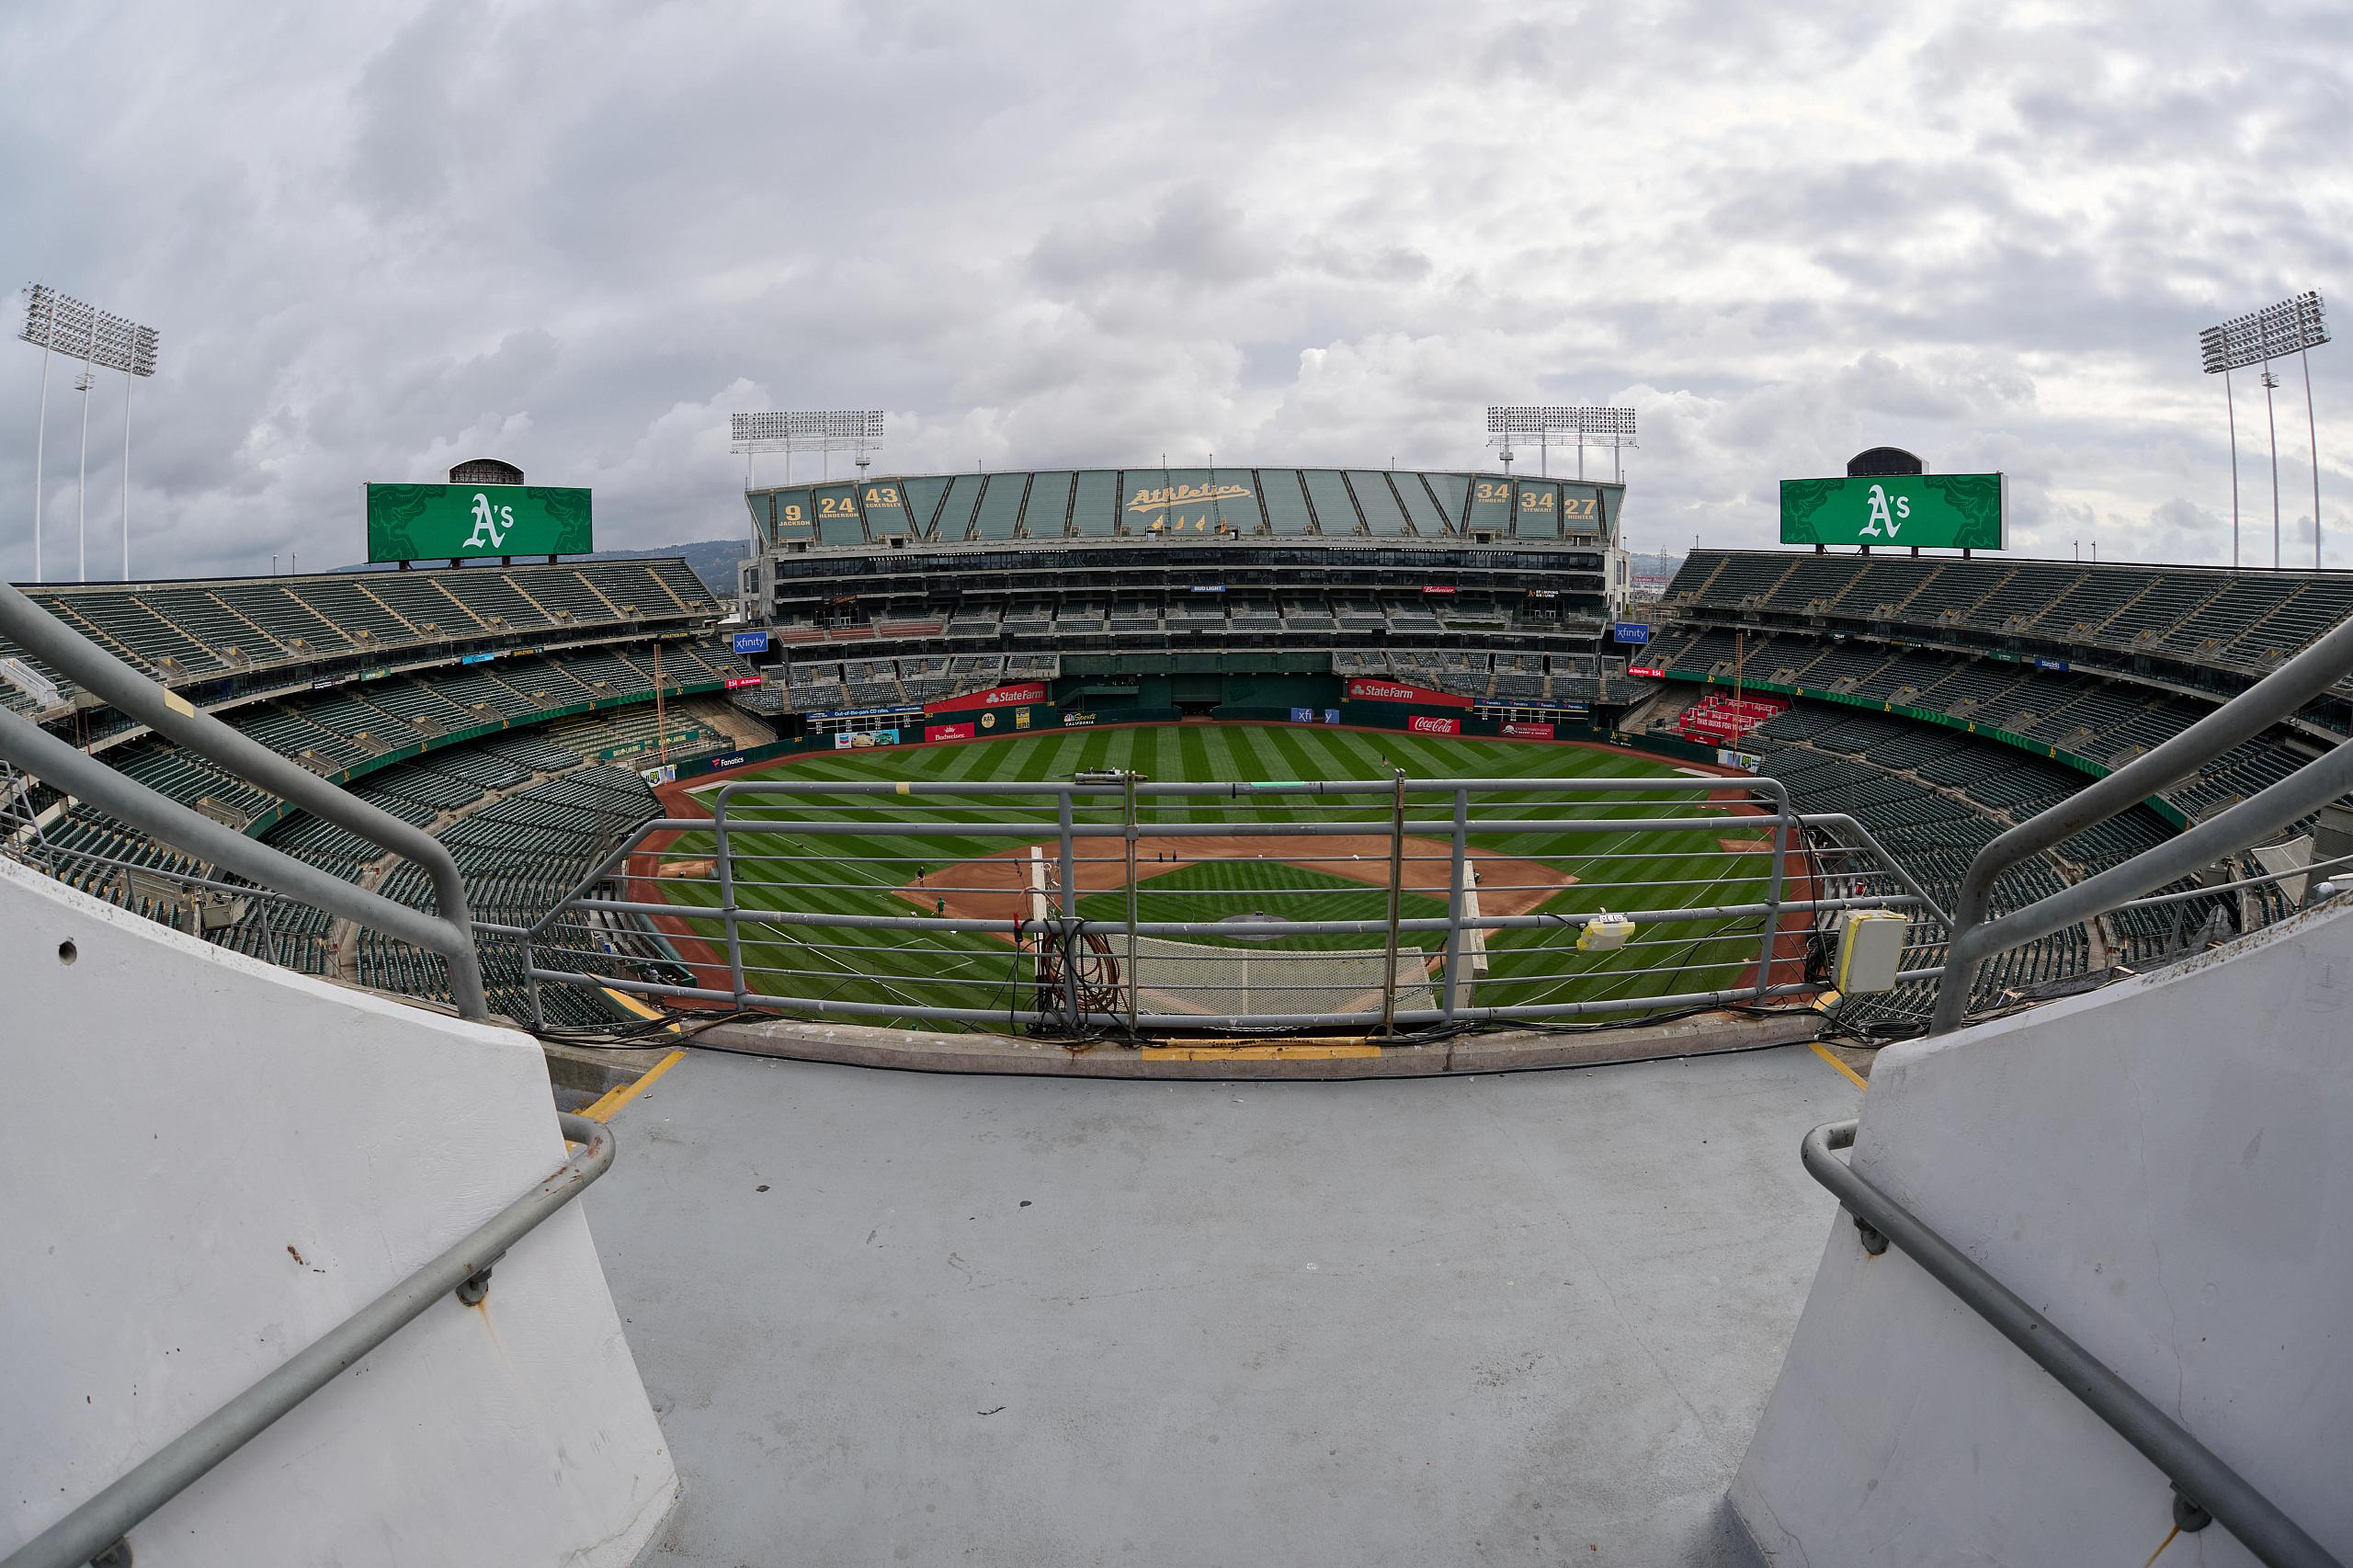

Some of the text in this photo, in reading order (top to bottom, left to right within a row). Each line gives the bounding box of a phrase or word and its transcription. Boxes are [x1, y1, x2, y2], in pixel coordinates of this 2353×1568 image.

[865, 488, 898, 504] 43
[1126, 483, 1250, 510] Athletics
[1477, 483, 1509, 499] 34
[821, 497, 855, 514] 24
[1521, 492, 1554, 508] 34
[1564, 499, 1597, 515] 27
[785, 505, 801, 521] 9
[1859, 484, 1910, 539] A's
[461, 493, 515, 549] A's
[1617, 628, 1646, 640] xfinity
[736, 638, 765, 649] xfinity
[1074, 712, 1097, 722] Sports
[1697, 717, 1708, 725] THIS
[1708, 719, 1722, 727] BUDS
[935, 732, 965, 741] Budweiser
[721, 756, 745, 767] Fanatics
